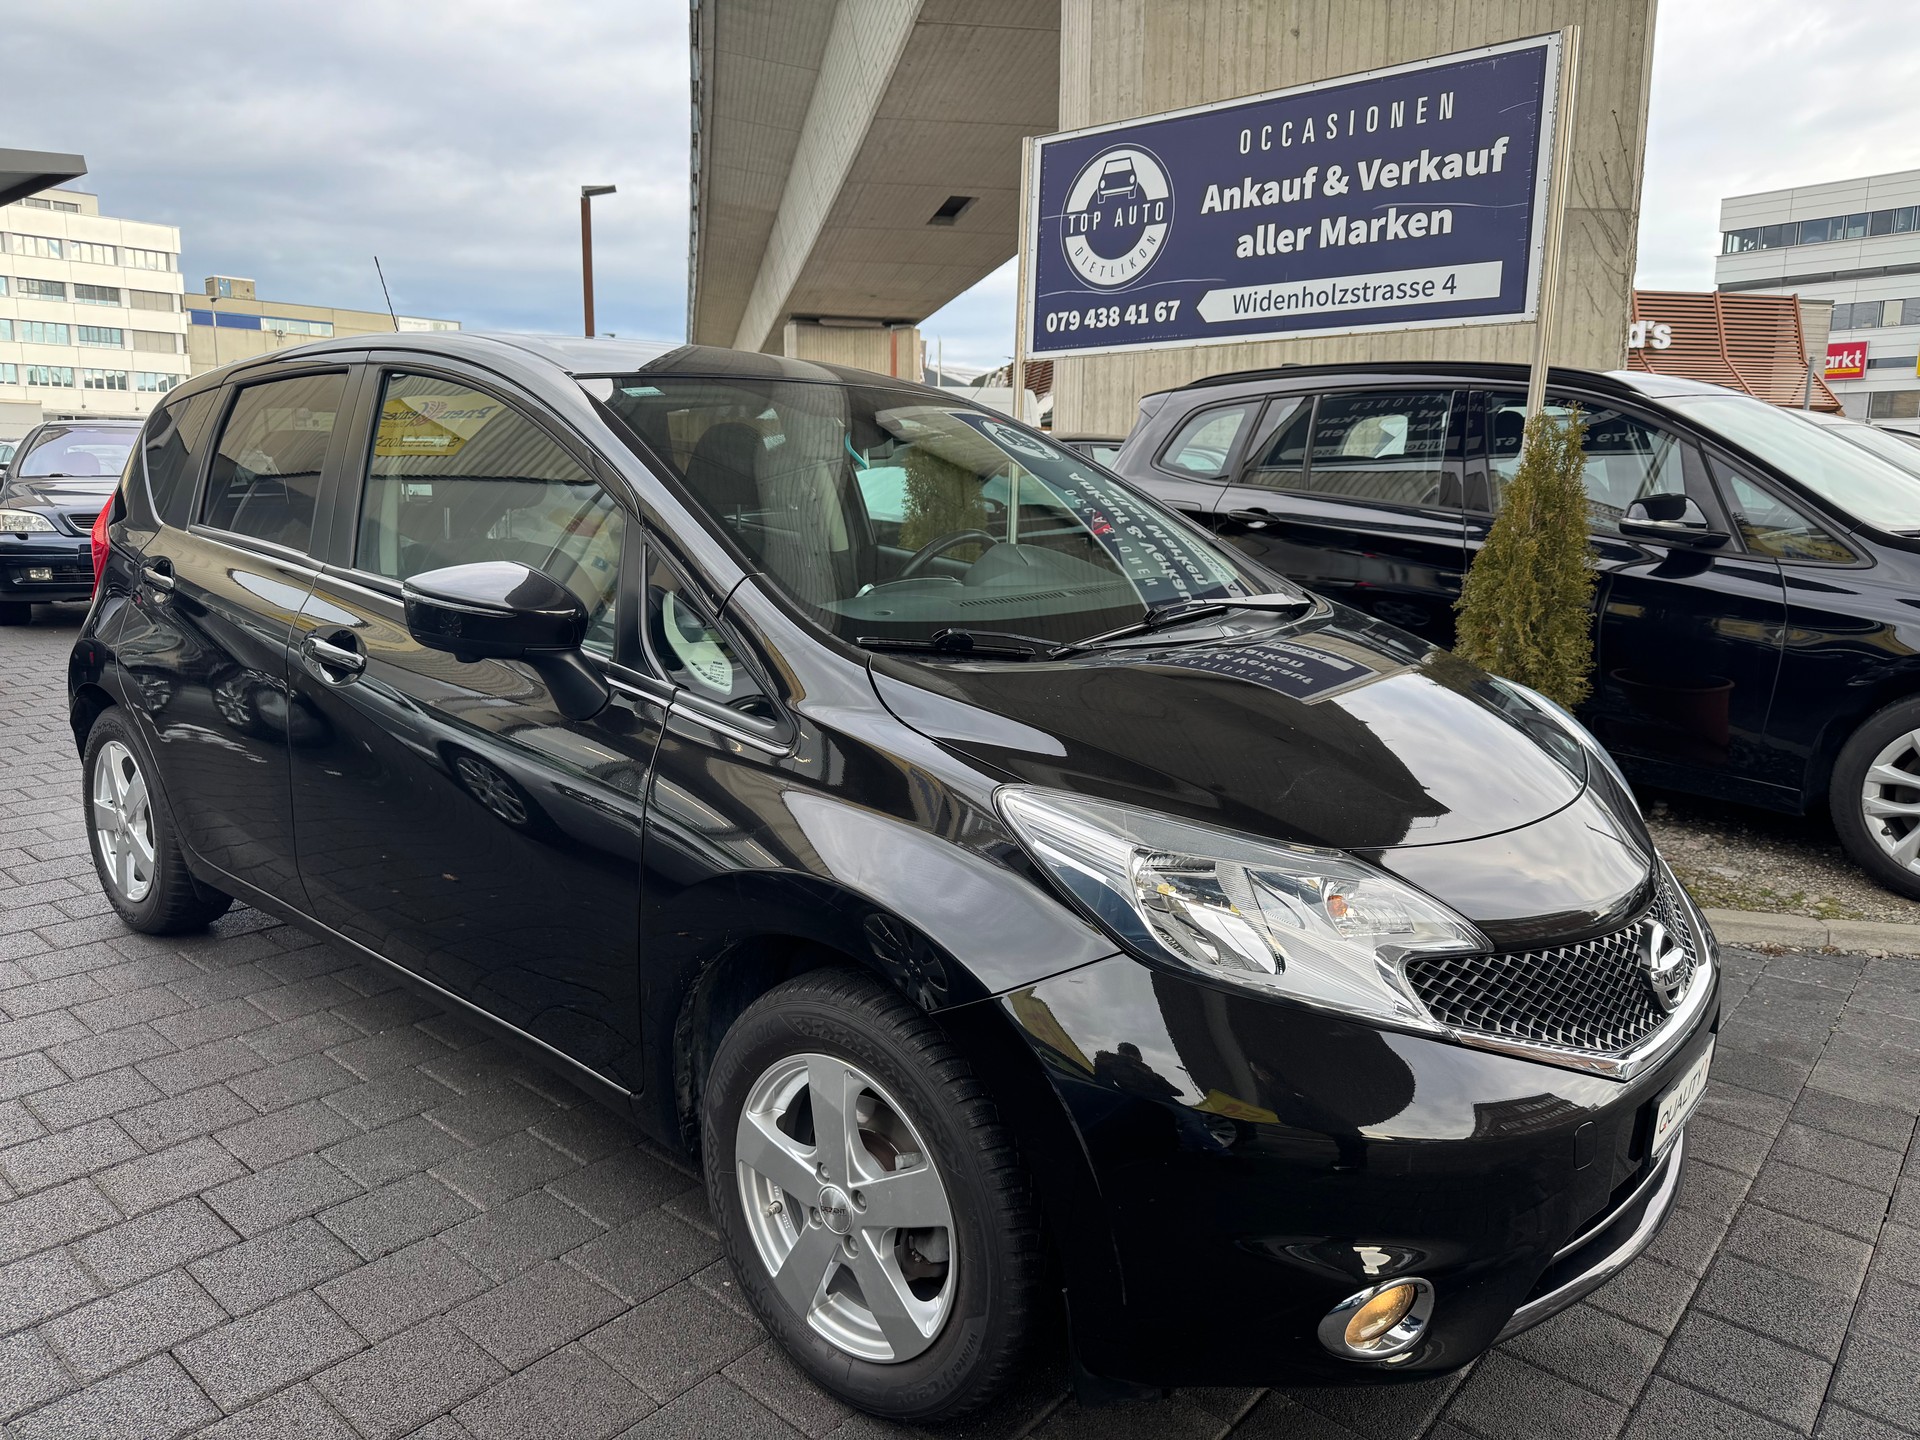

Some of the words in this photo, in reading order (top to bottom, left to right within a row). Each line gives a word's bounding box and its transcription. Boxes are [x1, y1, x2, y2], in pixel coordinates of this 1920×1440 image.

[1239, 91, 1454, 154] OCCASIONEN
[1200, 166, 1318, 214] Ankauf
[1322, 165, 1349, 196] &
[1357, 136, 1510, 191] Verkauf
[1068, 211, 1101, 233] TOP
[1114, 201, 1164, 227] AUTO
[1235, 223, 1312, 259] aller
[1319, 207, 1453, 249] Marken
[1074, 235, 1157, 278] DIETLIKON
[1232, 279, 1435, 315] Widenholzstrasse
[1442, 273, 1457, 295] 4
[1046, 310, 1081, 333] 079
[1084, 306, 1121, 329] 438
[1124, 303, 1149, 325] 41
[1154, 300, 1181, 323] 67
